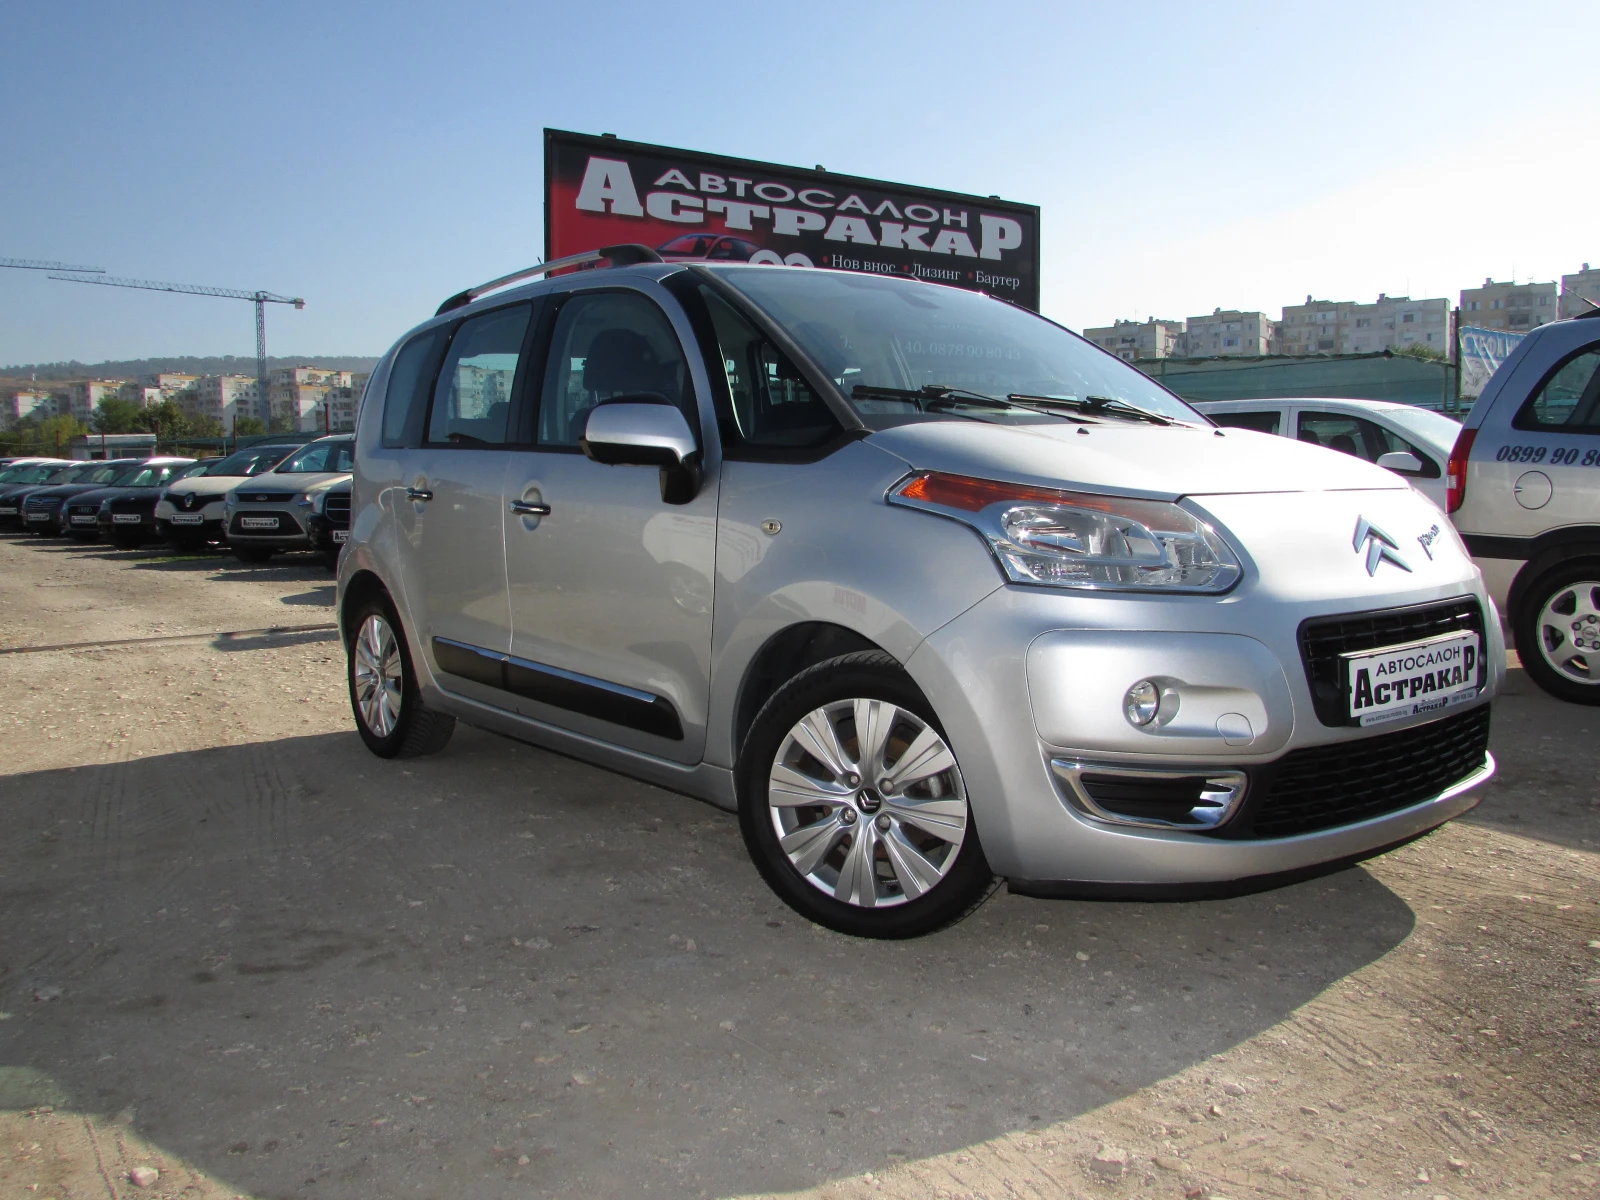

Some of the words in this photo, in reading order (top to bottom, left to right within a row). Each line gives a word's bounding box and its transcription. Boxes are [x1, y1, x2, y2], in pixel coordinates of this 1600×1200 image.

[654, 168, 968, 228] АВТОСАЛОН
[831, 254, 861, 272] Нов
[863, 259, 897, 274] внос
[911, 262, 962, 281] Лизинг
[975, 270, 1021, 289] Бартер
[1496, 445, 1547, 463] 0899
[1550, 447, 1579, 465] 90
[1376, 646, 1461, 677] АВТОСАЛОН
